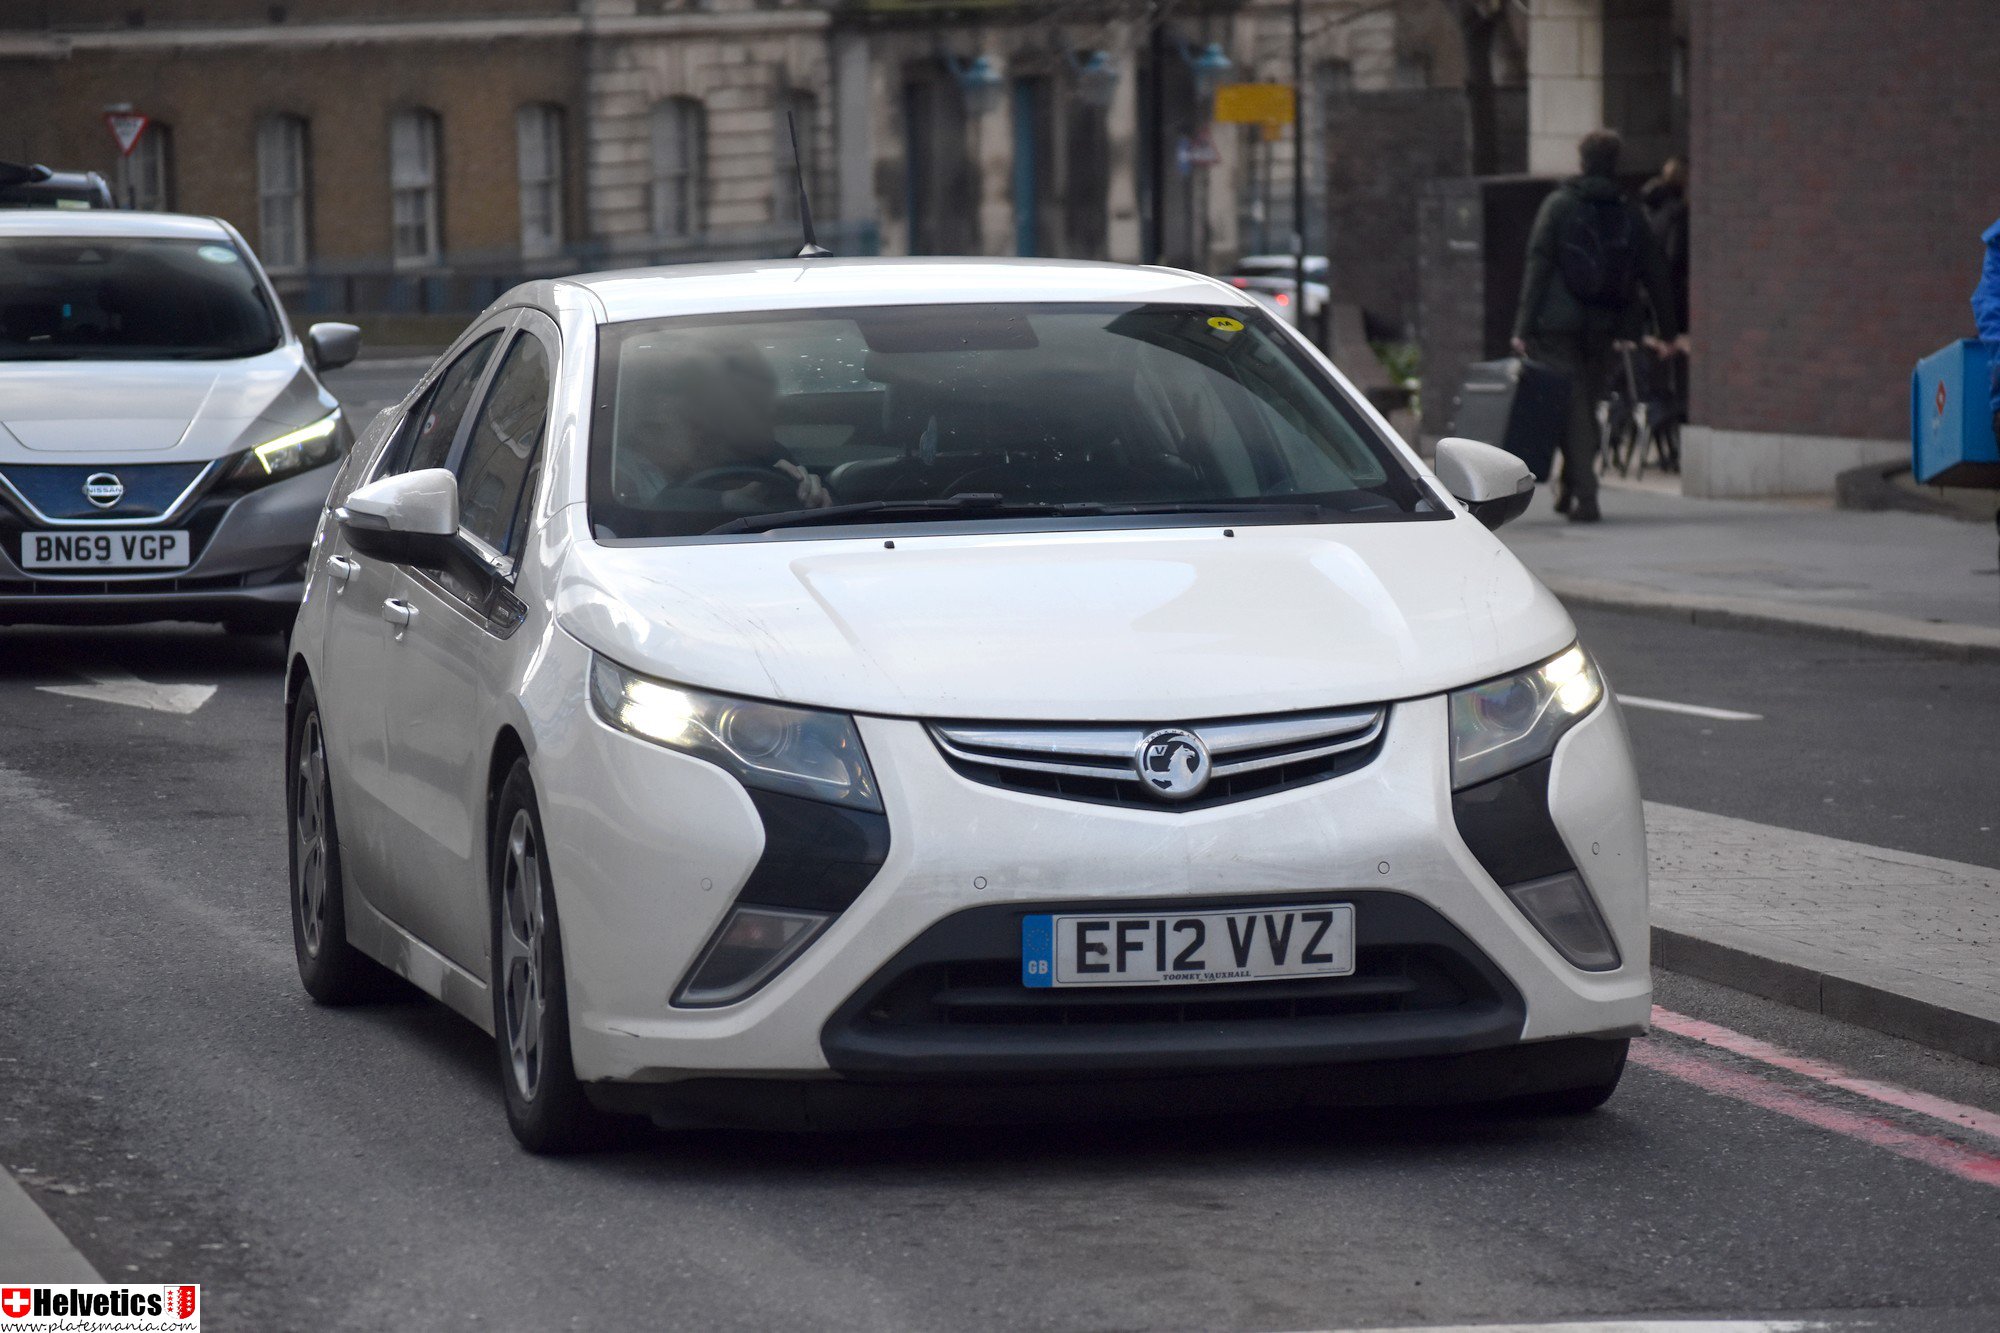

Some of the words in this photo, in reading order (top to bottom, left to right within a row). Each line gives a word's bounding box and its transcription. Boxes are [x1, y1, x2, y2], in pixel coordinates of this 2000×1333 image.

[36, 536, 111, 561] BN69
[121, 535, 176, 560] VGP
[1076, 919, 1206, 973] EF12
[1226, 911, 1333, 968] VVZ
[1028, 960, 1048, 975] GB
[1204, 971, 1251, 979] VAUXHALL
